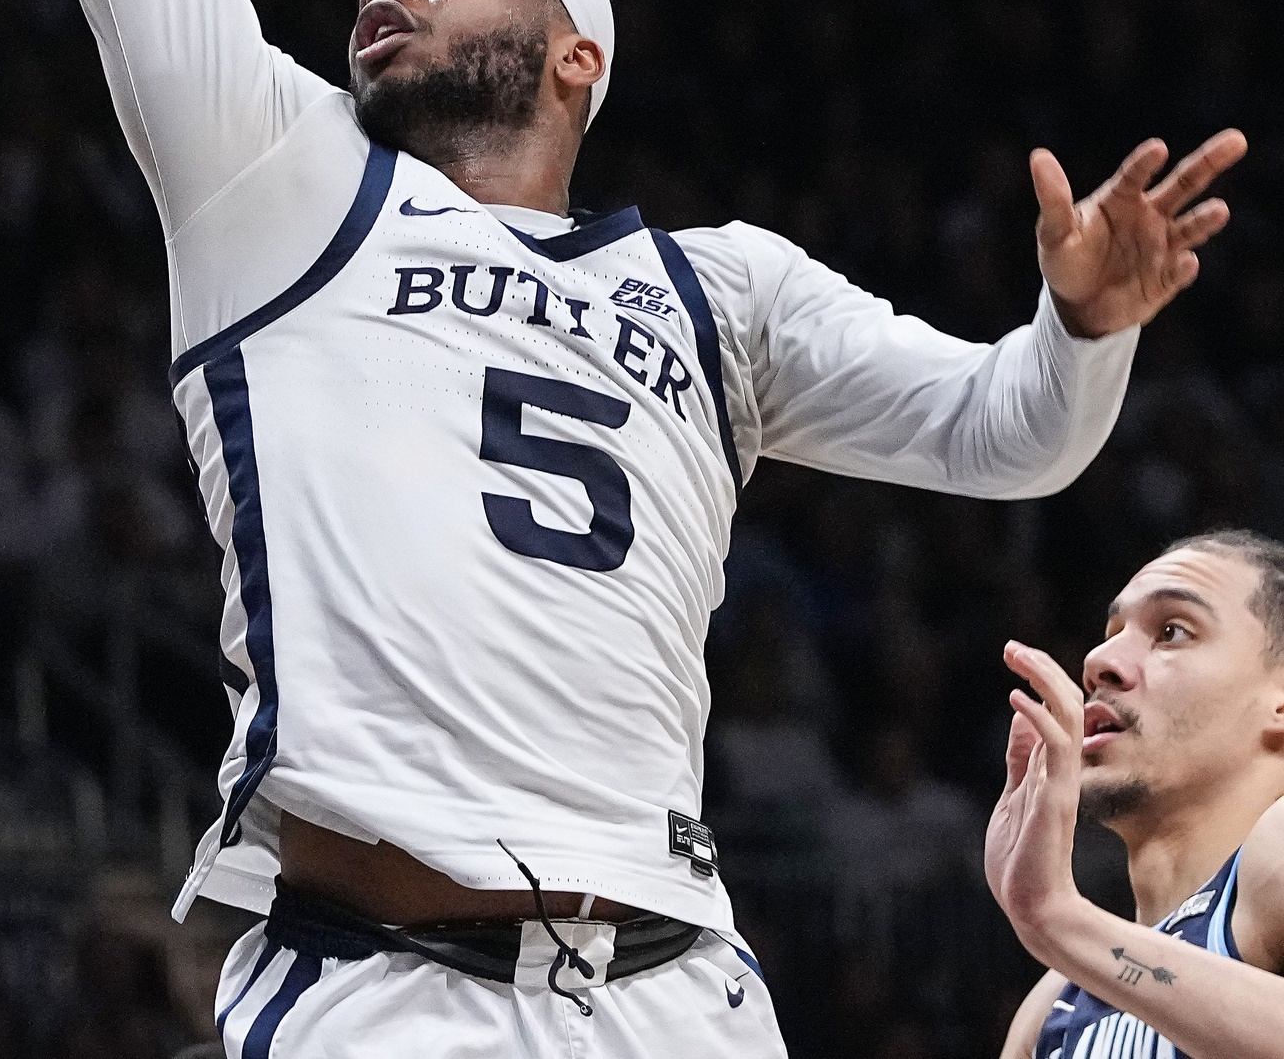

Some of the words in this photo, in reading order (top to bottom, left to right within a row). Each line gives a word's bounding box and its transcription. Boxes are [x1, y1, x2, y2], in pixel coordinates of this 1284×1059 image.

[618, 277, 670, 300] BIG
[609, 290, 678, 315] EAST
[479, 366, 635, 572] 5
